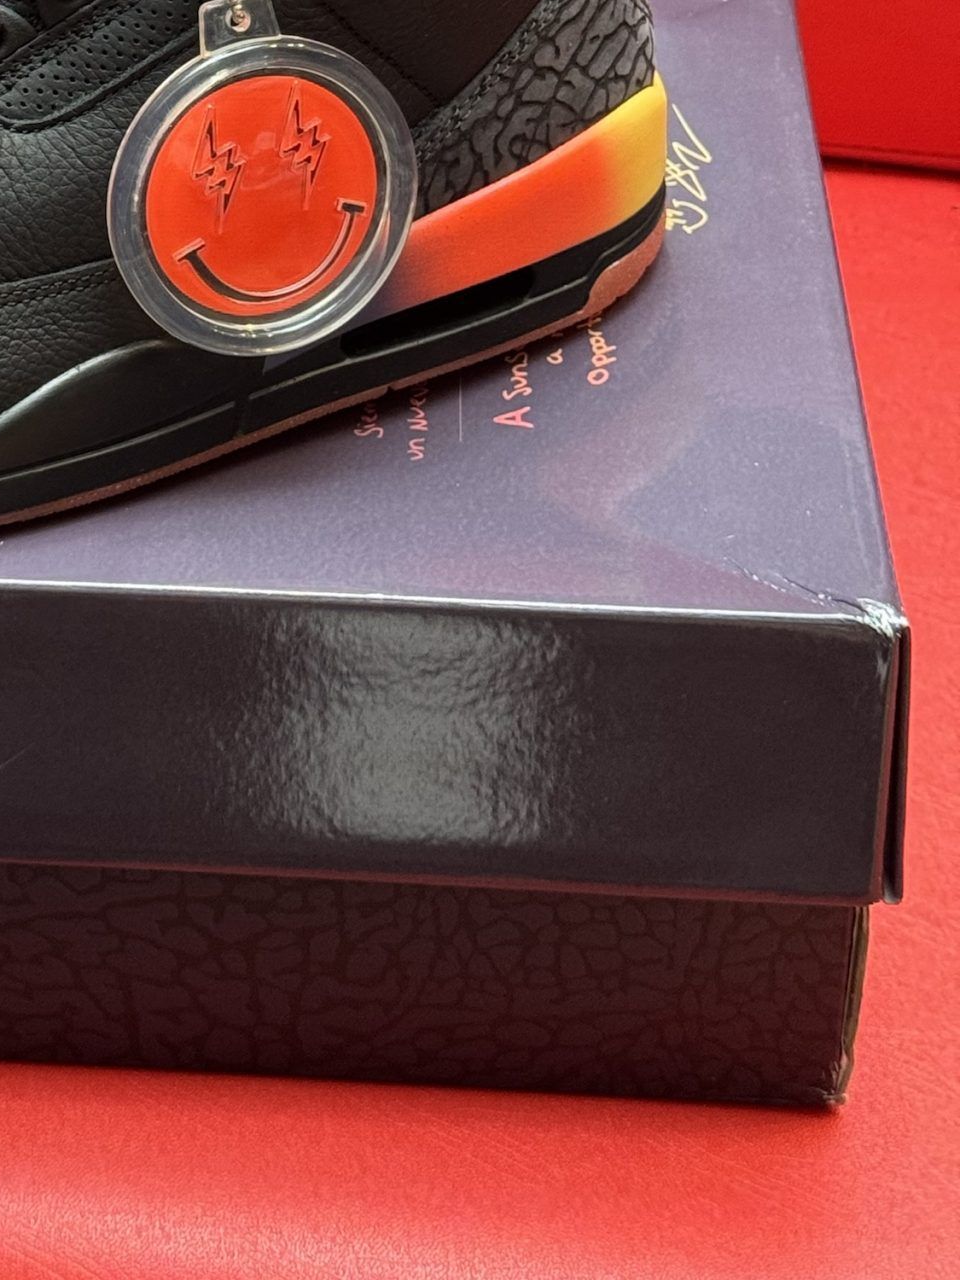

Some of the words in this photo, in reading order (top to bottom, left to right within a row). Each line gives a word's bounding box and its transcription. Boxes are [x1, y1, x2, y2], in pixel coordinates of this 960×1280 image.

[546, 347, 564, 365] a
[492, 405, 535, 429] A
[406, 437, 426, 461] un
